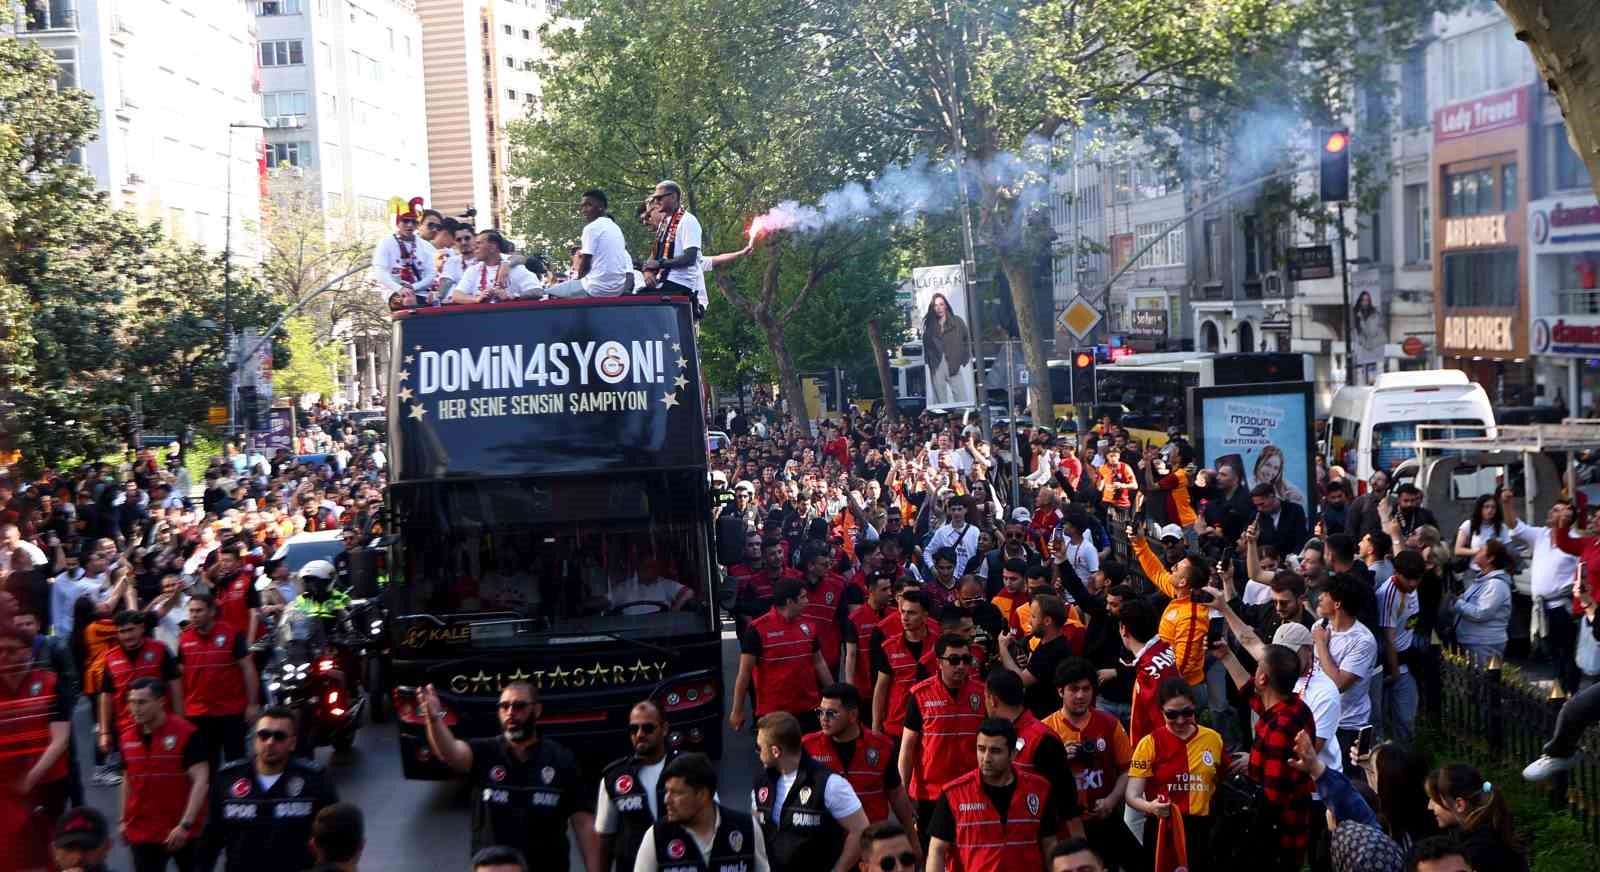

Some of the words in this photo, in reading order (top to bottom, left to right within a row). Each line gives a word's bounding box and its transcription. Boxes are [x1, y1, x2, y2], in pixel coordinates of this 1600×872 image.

[1441, 107, 1472, 133] Lady
[1474, 93, 1518, 128] Travel
[438, 399, 466, 420] HER
[471, 396, 508, 417] SENE
[430, 625, 470, 640] KALE
[450, 658, 668, 693] GALATASARAY
[1175, 773, 1203, 782] TÜRK
